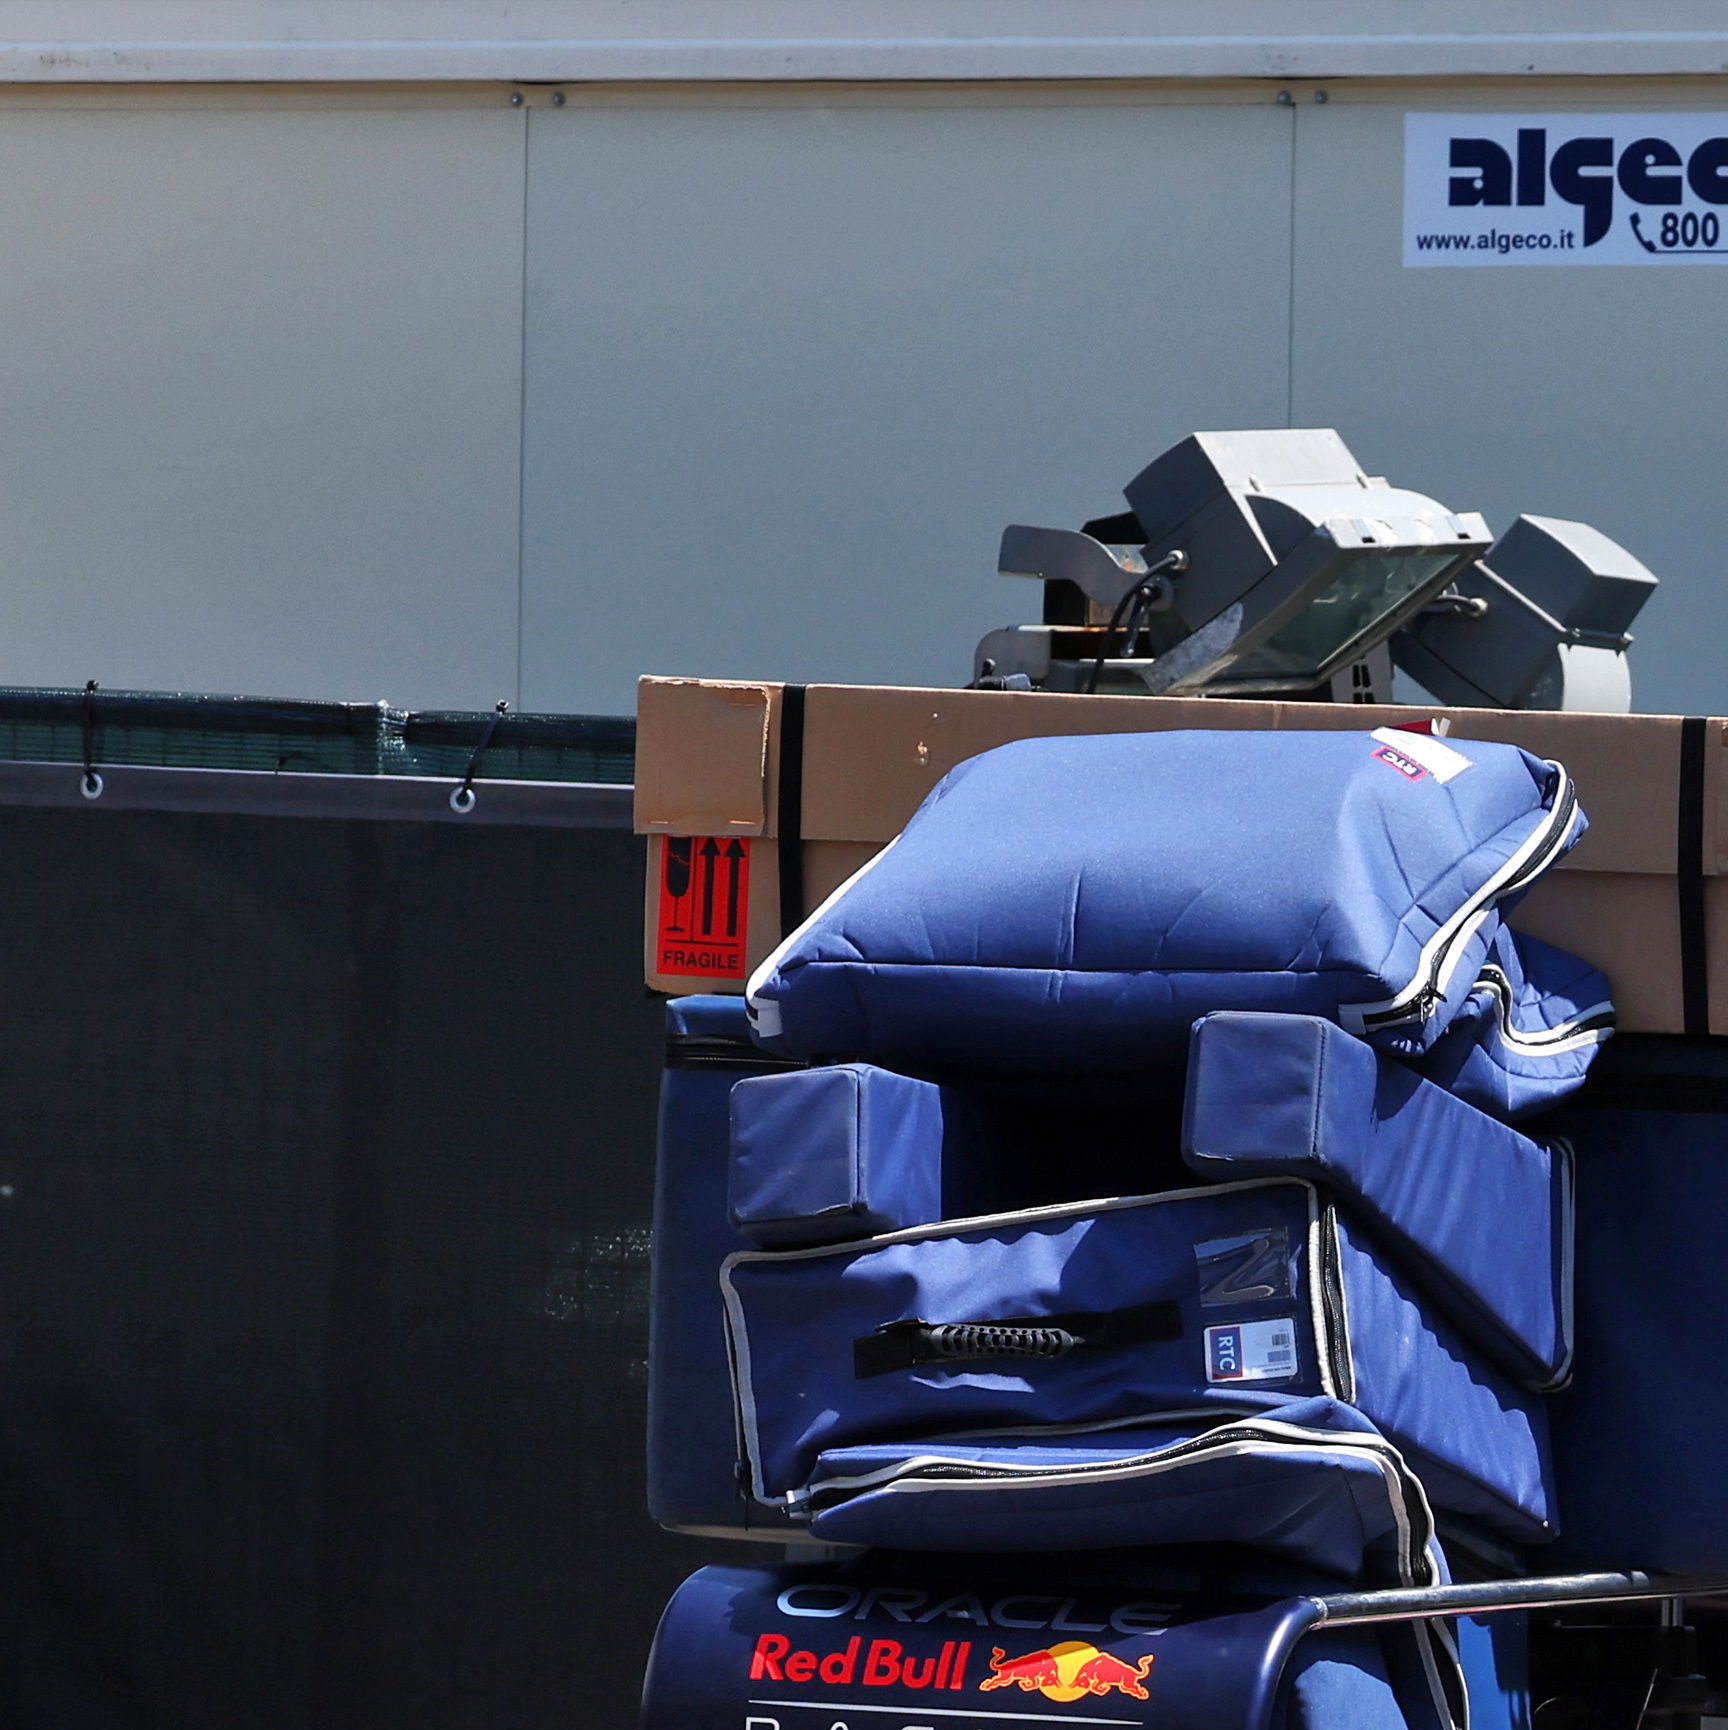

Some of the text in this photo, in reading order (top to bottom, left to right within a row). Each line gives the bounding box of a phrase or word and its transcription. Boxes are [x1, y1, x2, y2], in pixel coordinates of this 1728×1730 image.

[1417, 230, 1574, 254] www.algeco.it
[1660, 211, 1720, 248] 800
[663, 950, 739, 970] FRAGILE
[1218, 1335, 1236, 1370] RTC
[776, 1583, 1183, 1636] ORACLE
[749, 1633, 971, 1691] Red Bull
